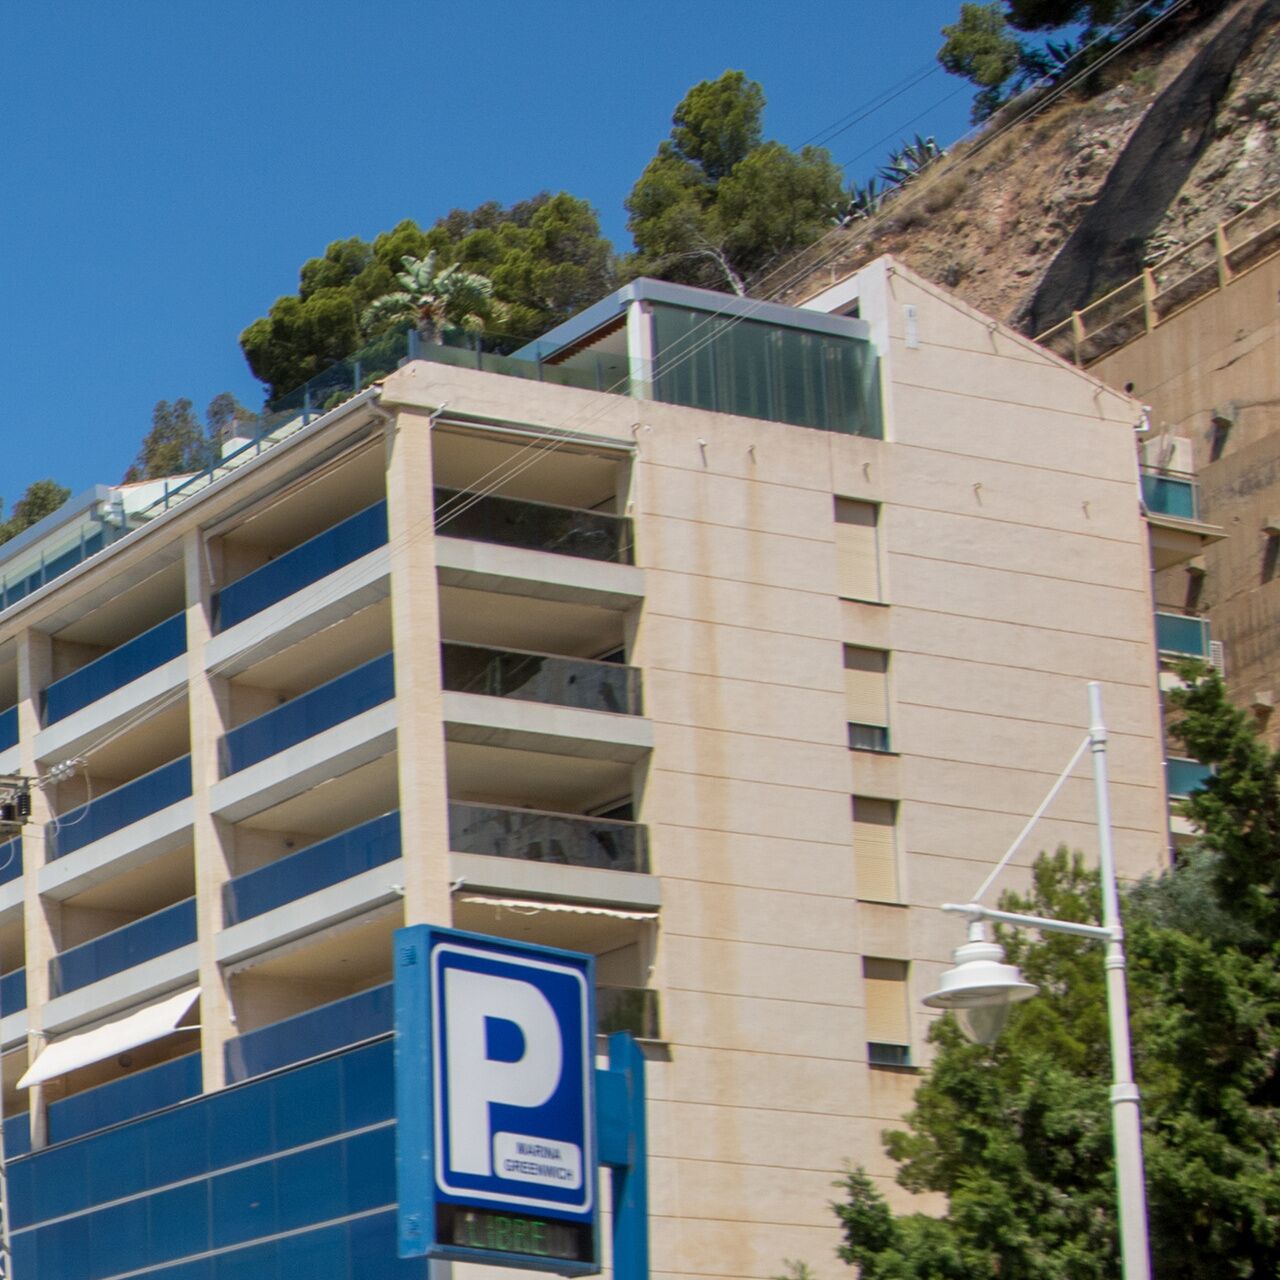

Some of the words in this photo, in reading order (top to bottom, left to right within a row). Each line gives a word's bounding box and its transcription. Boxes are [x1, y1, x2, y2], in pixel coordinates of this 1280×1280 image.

[444, 967, 563, 1177] P
[516, 1142, 561, 1160] MARINA
[504, 1159, 575, 1181] GREENWICH
